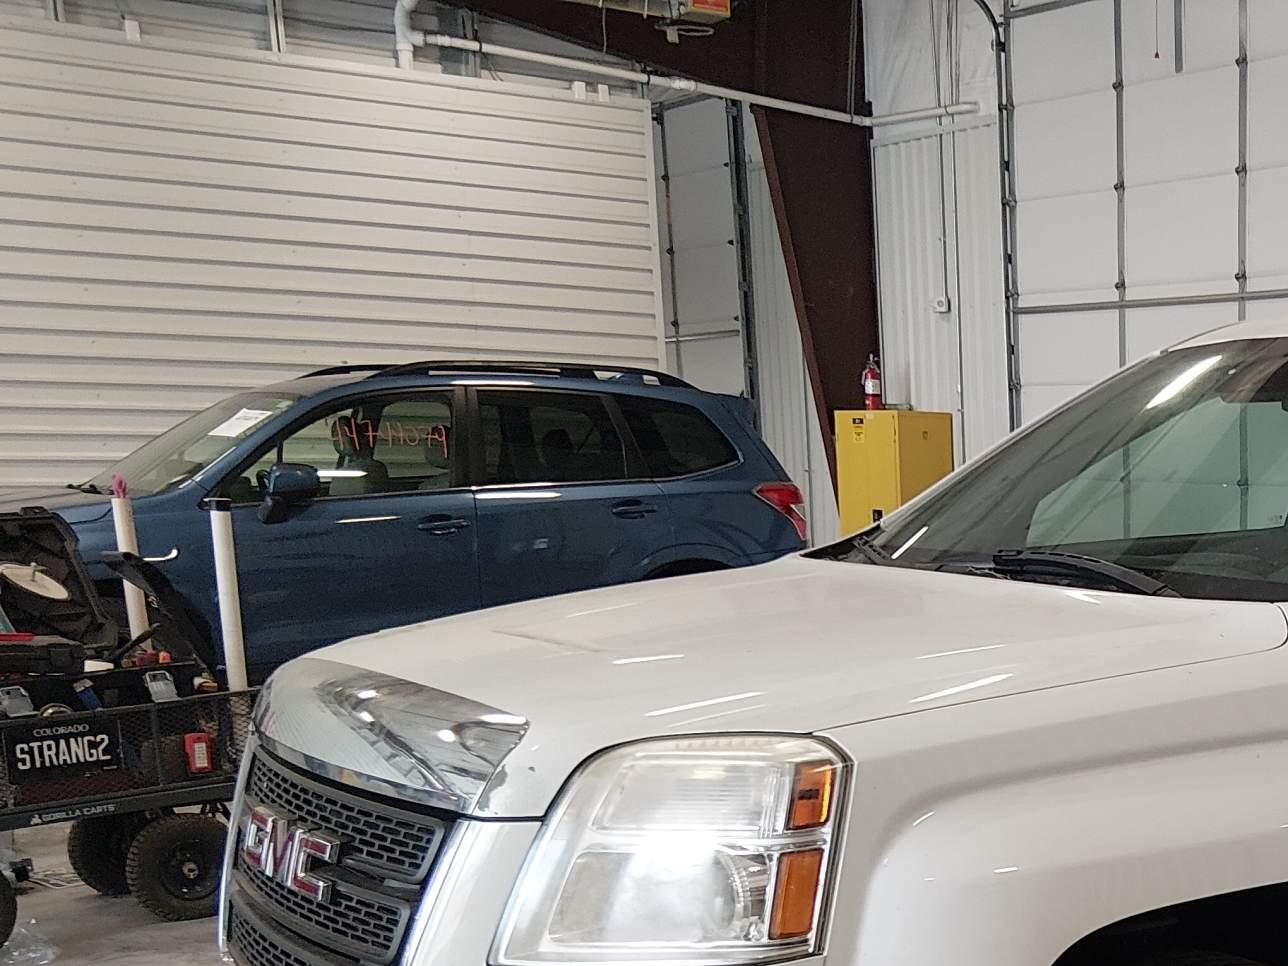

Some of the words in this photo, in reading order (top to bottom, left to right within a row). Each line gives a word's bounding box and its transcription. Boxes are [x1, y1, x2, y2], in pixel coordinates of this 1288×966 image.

[33, 723, 90, 736] COLORADO
[15, 734, 112, 769] STRANG2
[83, 804, 115, 816] CARTS
[242, 807, 341, 904] GMC
